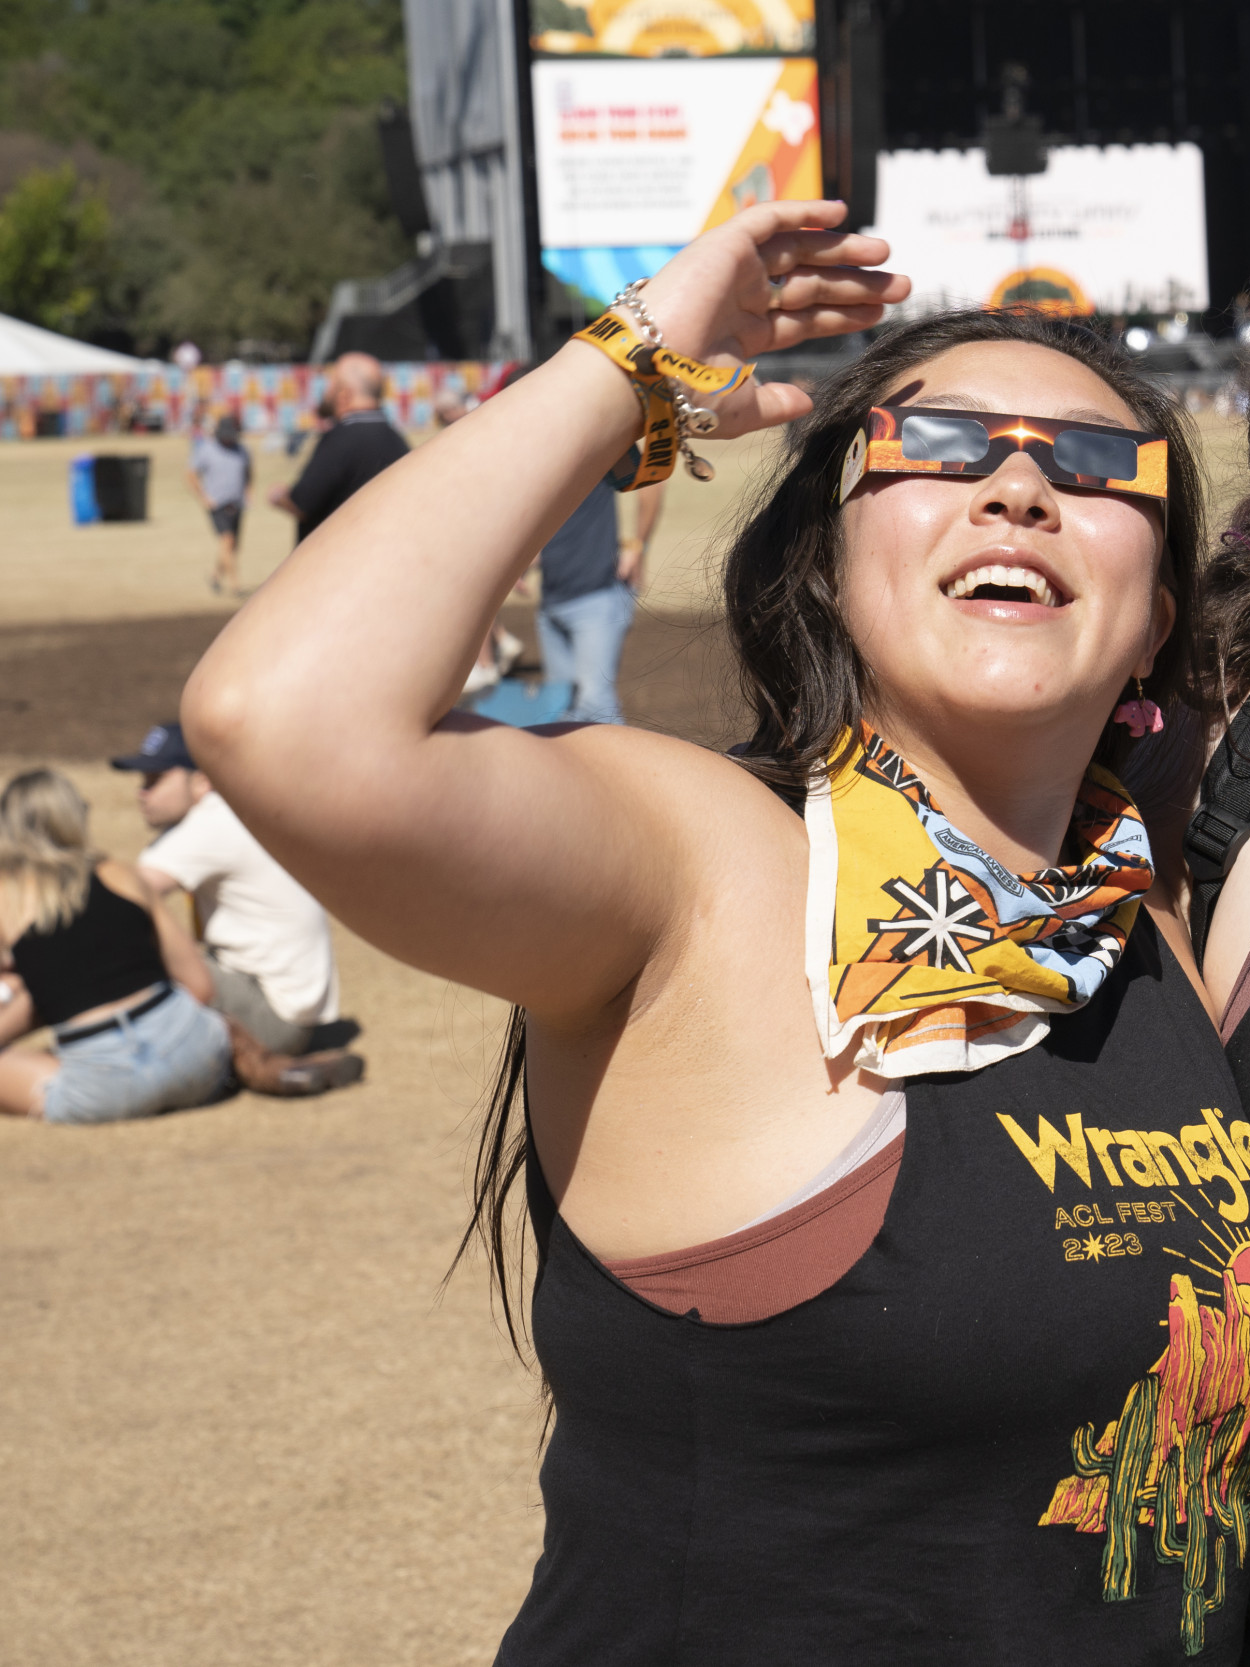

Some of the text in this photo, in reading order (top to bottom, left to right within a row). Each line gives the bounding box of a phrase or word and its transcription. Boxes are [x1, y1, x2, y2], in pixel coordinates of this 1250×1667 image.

[941, 834, 1019, 891] AMERICAN EXPRESS
[1055, 1201, 1177, 1230] ACL FEST
